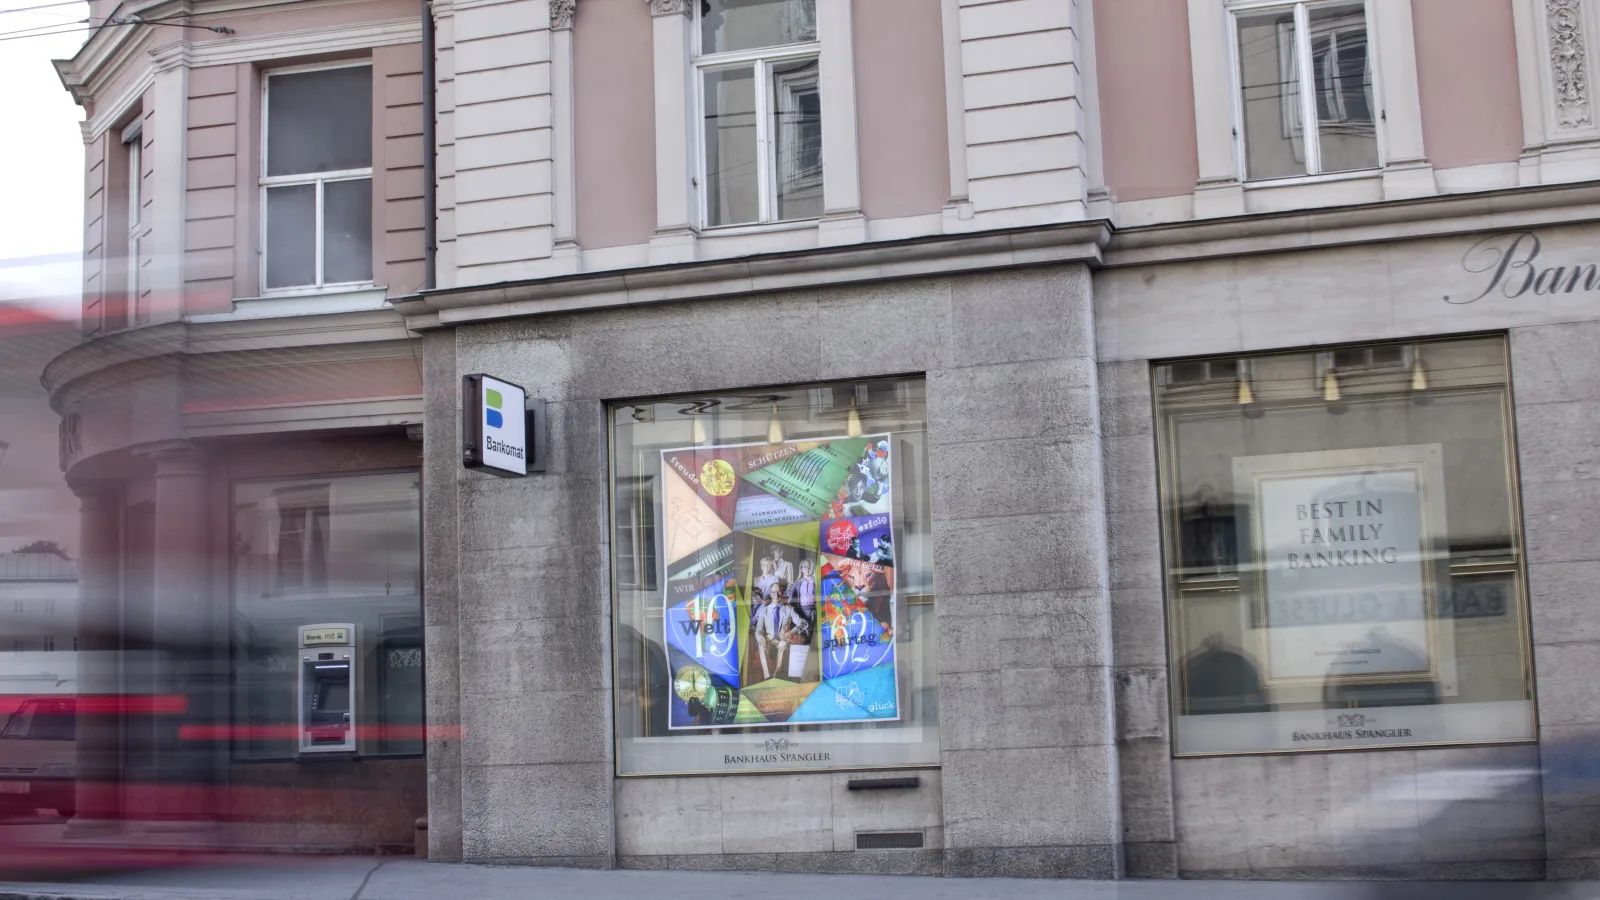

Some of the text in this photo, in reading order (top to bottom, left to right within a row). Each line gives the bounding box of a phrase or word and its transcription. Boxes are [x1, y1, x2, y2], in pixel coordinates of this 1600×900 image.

[1443, 230, 1600, 305] Ban
[486, 435, 524, 460] Bankomat
[747, 445, 797, 469] SCHÜTZEN
[670, 455, 701, 486] freude
[1296, 498, 1384, 521] BEST IN
[857, 515, 888, 533] erfolg
[1299, 522, 1385, 545] FAMILY
[847, 558, 862, 568] IHR
[1287, 546, 1398, 570] BANKING
[673, 583, 696, 594] WIR
[324, 632, 335, 640] mit
[678, 618, 731, 637] Welt
[823, 631, 878, 651] spartag
[868, 700, 895, 713] glück
[1291, 730, 1353, 742] BANKHAUS
[724, 753, 778, 764] BANKHAUS
